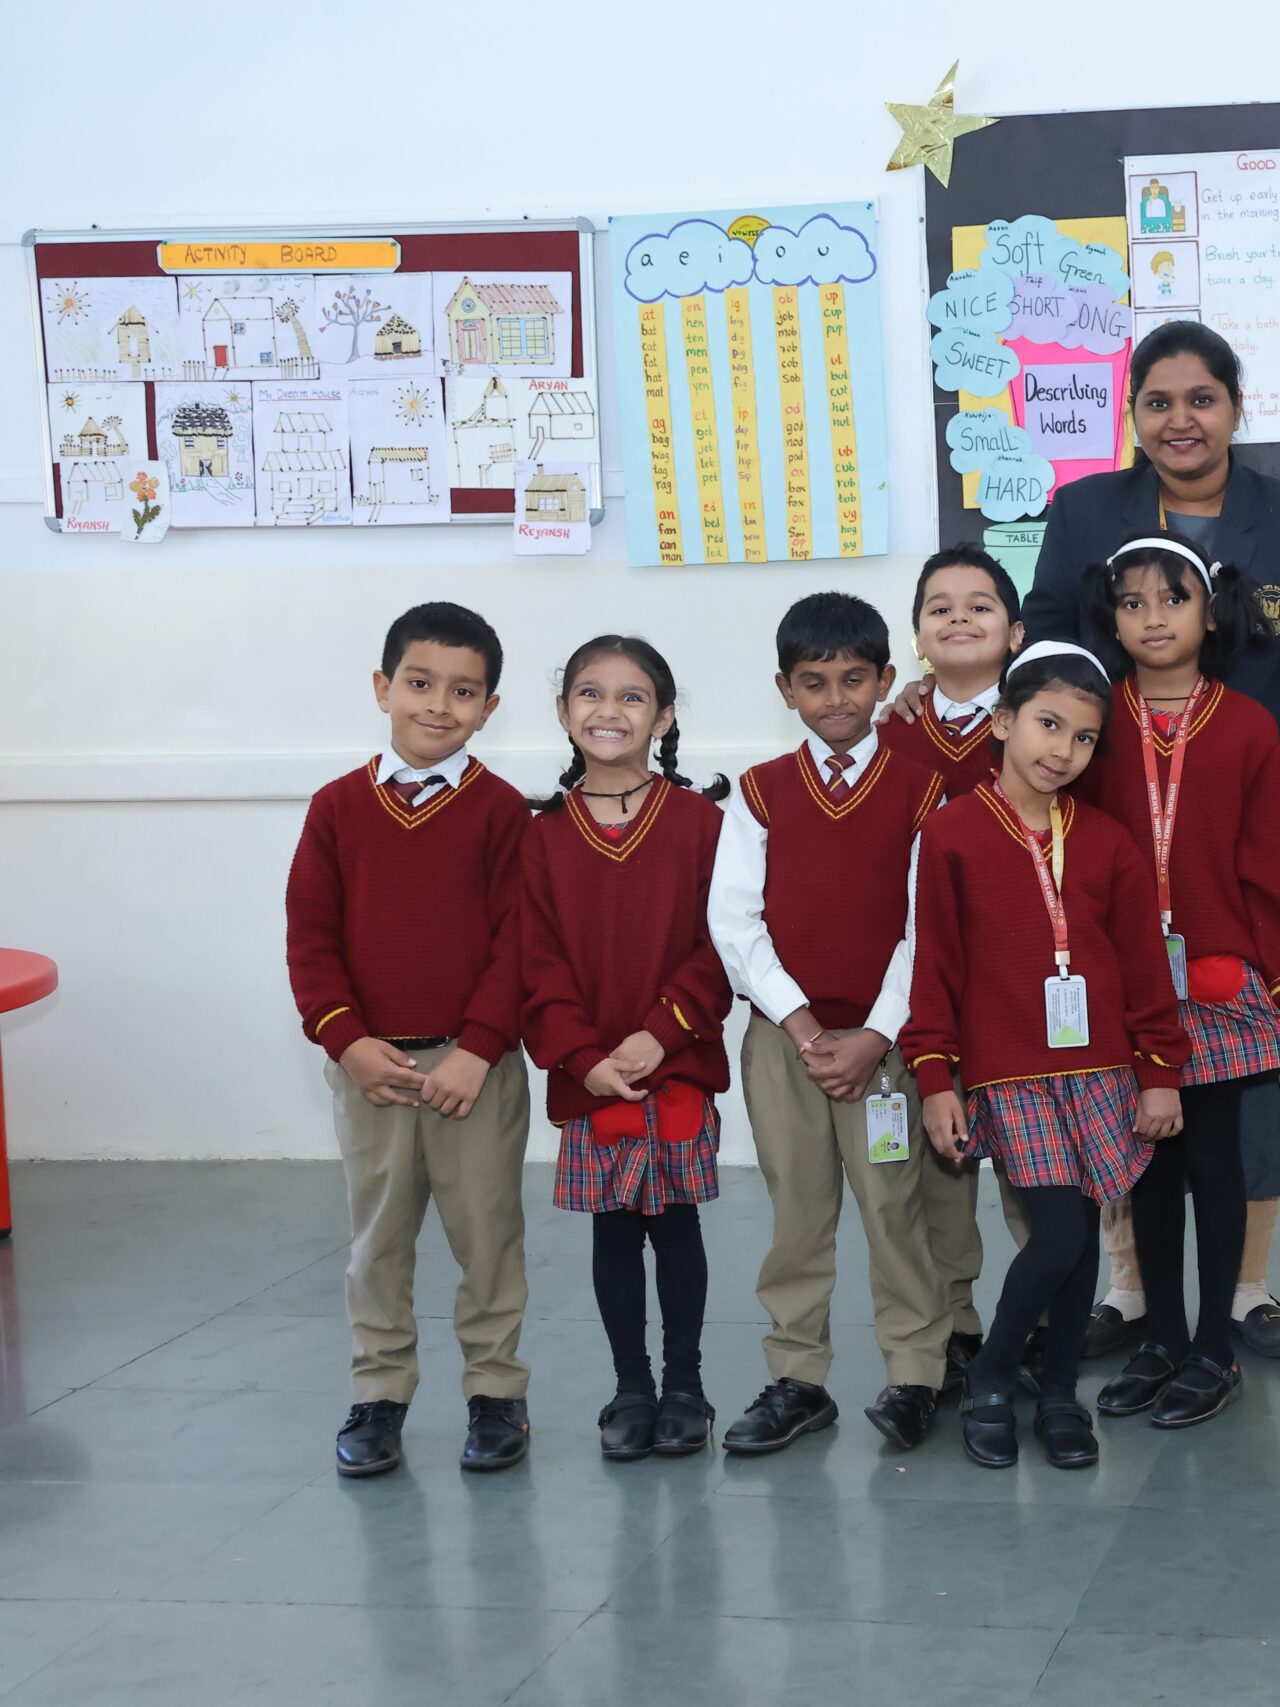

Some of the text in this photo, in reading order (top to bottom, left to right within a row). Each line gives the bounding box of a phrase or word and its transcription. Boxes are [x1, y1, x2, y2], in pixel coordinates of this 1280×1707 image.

[1237, 153, 1276, 171] GOOD
[1202, 188, 1223, 204] Get
[1250, 187, 1278, 204] early
[1217, 208, 1235, 221] the
[185, 245, 337, 264] ACTIVITY BOARD
[641, 245, 830, 266] a e o u
[992, 231, 1045, 275] Soft
[1059, 251, 1105, 283] Green
[825, 292, 838, 305] up
[945, 291, 997, 318] NICE
[1010, 294, 1065, 317] SHORT
[643, 308, 656, 320] at
[776, 310, 794, 326] job
[823, 308, 842, 320] cup
[1069, 304, 1127, 337] ONG
[641, 324, 656, 336] bat
[778, 325, 797, 337] mob
[686, 348, 708, 357] men
[782, 357, 799, 368] cob
[945, 342, 1010, 379] SWEET
[645, 369, 662, 382] hat
[529, 379, 568, 390] ARYAN
[646, 386, 664, 397] mat
[1025, 373, 1107, 407] Describing
[652, 419, 666, 434] ag
[1040, 410, 1087, 434] Words
[652, 433, 669, 447] bag
[961, 427, 1019, 452] Small
[656, 481, 671, 494] rag
[985, 476, 1042, 502] HARD
[659, 511, 675, 520] an
[518, 524, 570, 539] REYANSH
[1005, 533, 1039, 544] TABLE
